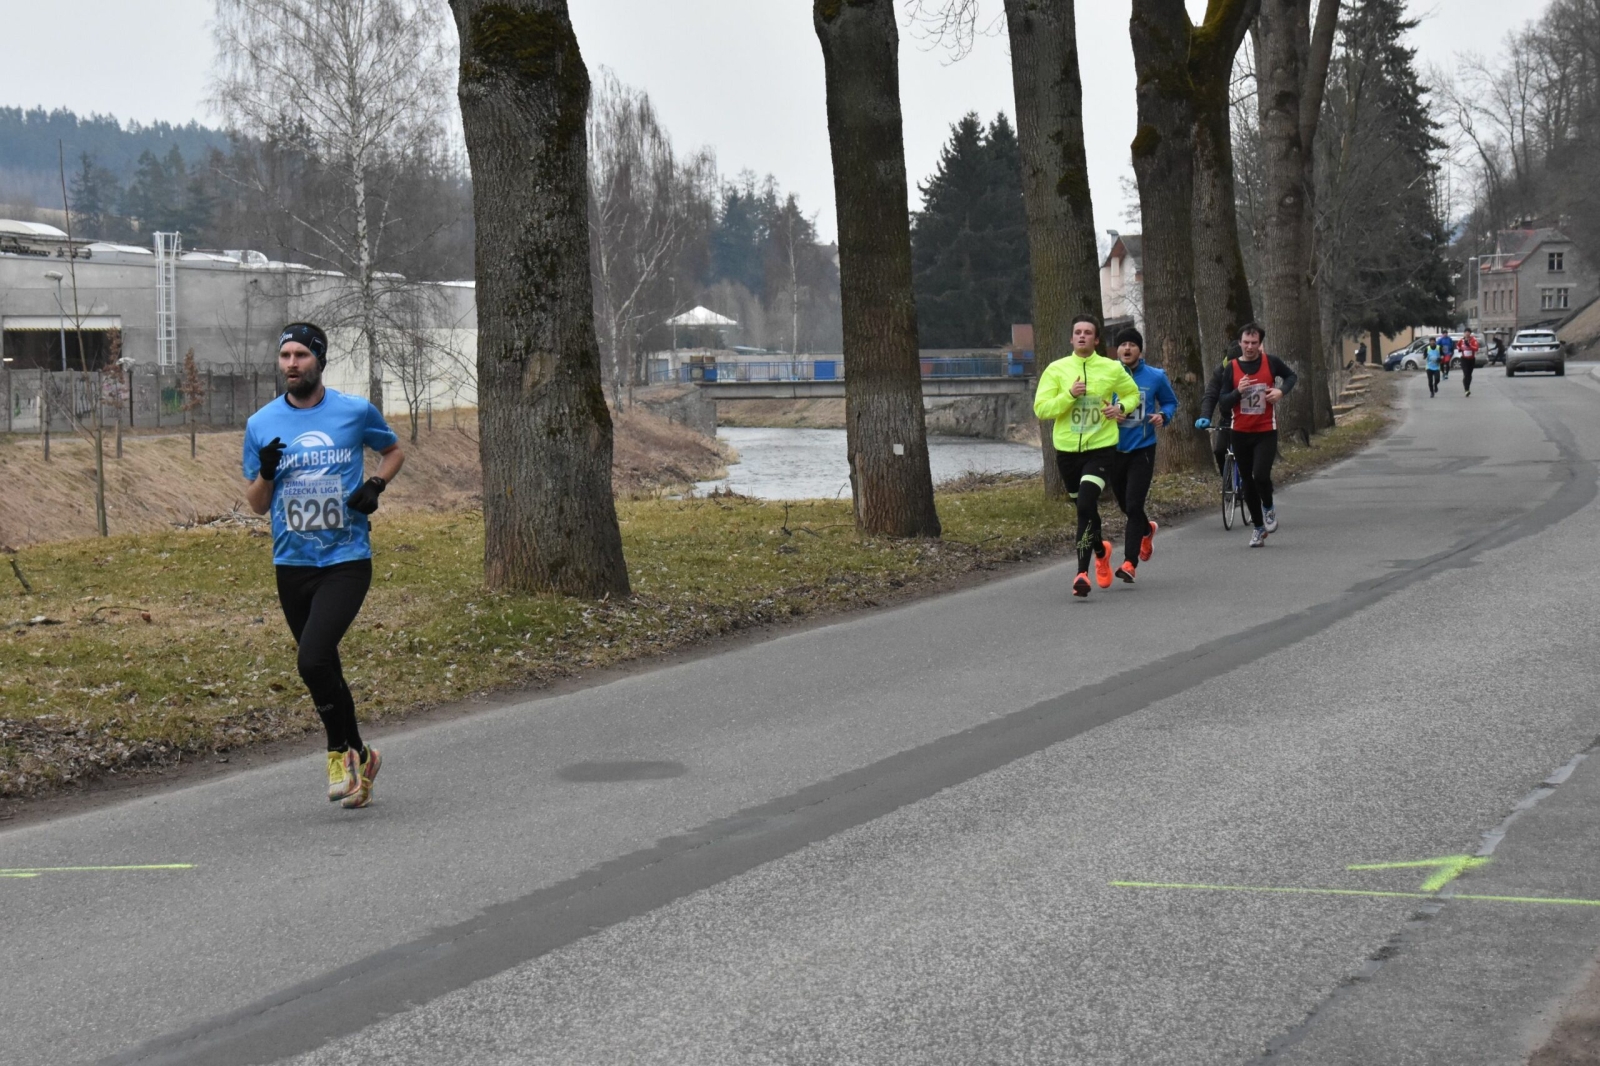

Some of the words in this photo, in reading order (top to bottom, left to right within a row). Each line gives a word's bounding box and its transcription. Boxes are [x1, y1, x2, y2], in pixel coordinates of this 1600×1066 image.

[1247, 394, 1260, 408] 12
[1071, 407, 1100, 425] 670
[276, 448, 351, 470] ONLABERUN
[320, 486, 338, 494] LIGA
[288, 498, 341, 531] 626
